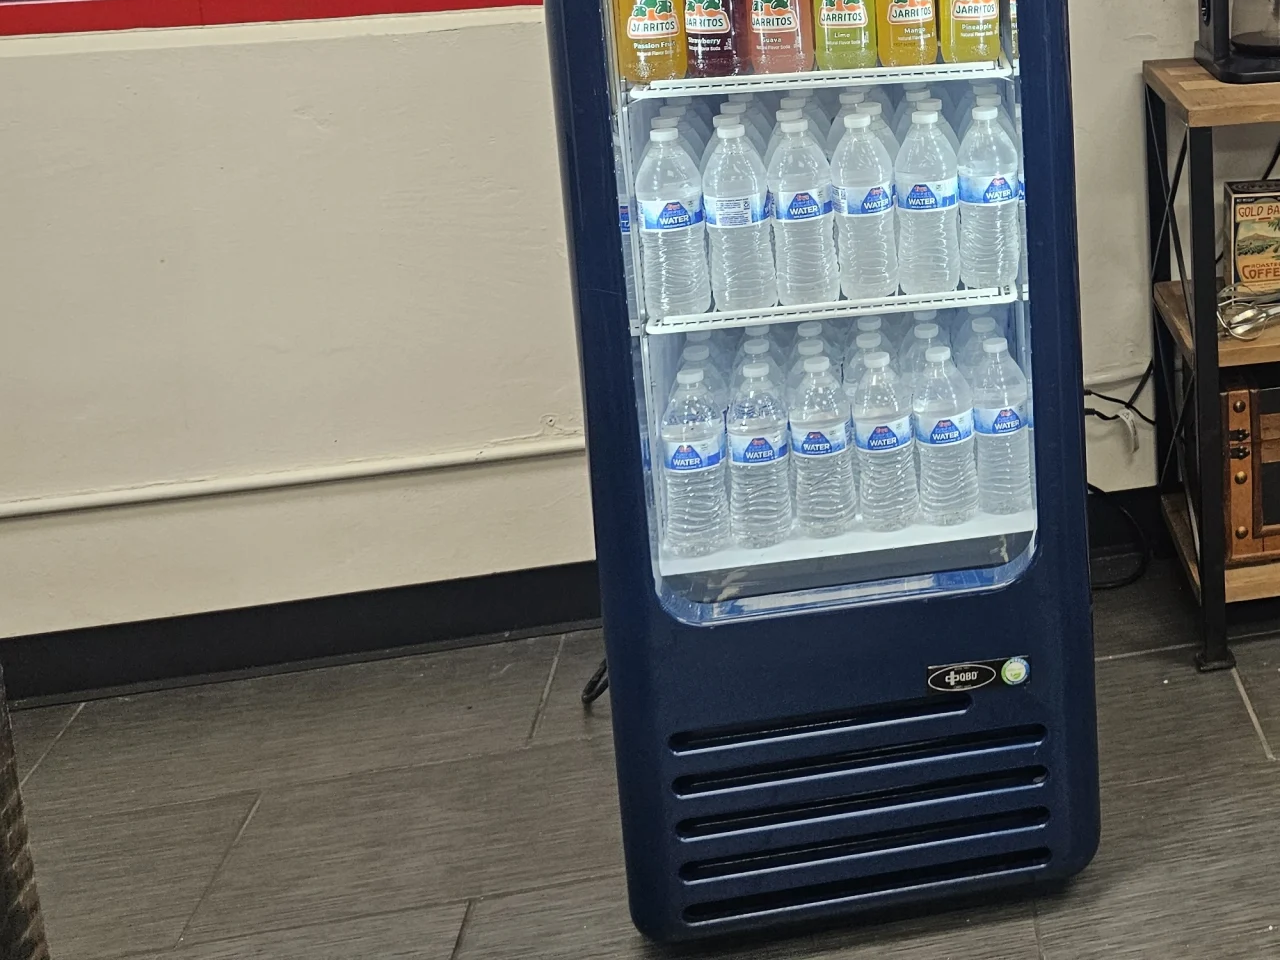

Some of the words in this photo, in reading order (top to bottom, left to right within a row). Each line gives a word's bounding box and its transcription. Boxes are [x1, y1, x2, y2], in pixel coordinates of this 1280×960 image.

[892, 6, 932, 18] JARRITOS
[956, 4, 994, 14] JARRITOS
[752, 16, 792, 27] JARRITOS
[822, 12, 862, 22] JARRITOS
[962, 22, 992, 30] Pineapple
[634, 42, 660, 50] Passion
[986, 189, 1012, 200] WATER
[864, 198, 889, 210] WATER
[908, 198, 936, 206] WATER
[790, 205, 818, 215] WATER
[1238, 206, 1264, 218] GOLD
[660, 215, 689, 225] WATER
[994, 420, 1020, 430] WATER
[932, 431, 959, 440] WATER
[804, 442, 830, 451] WATER
[870, 437, 896, 447] WATER
[746, 450, 773, 458] WATER
[672, 458, 700, 466] WATER
[960, 672, 978, 682] QBD
